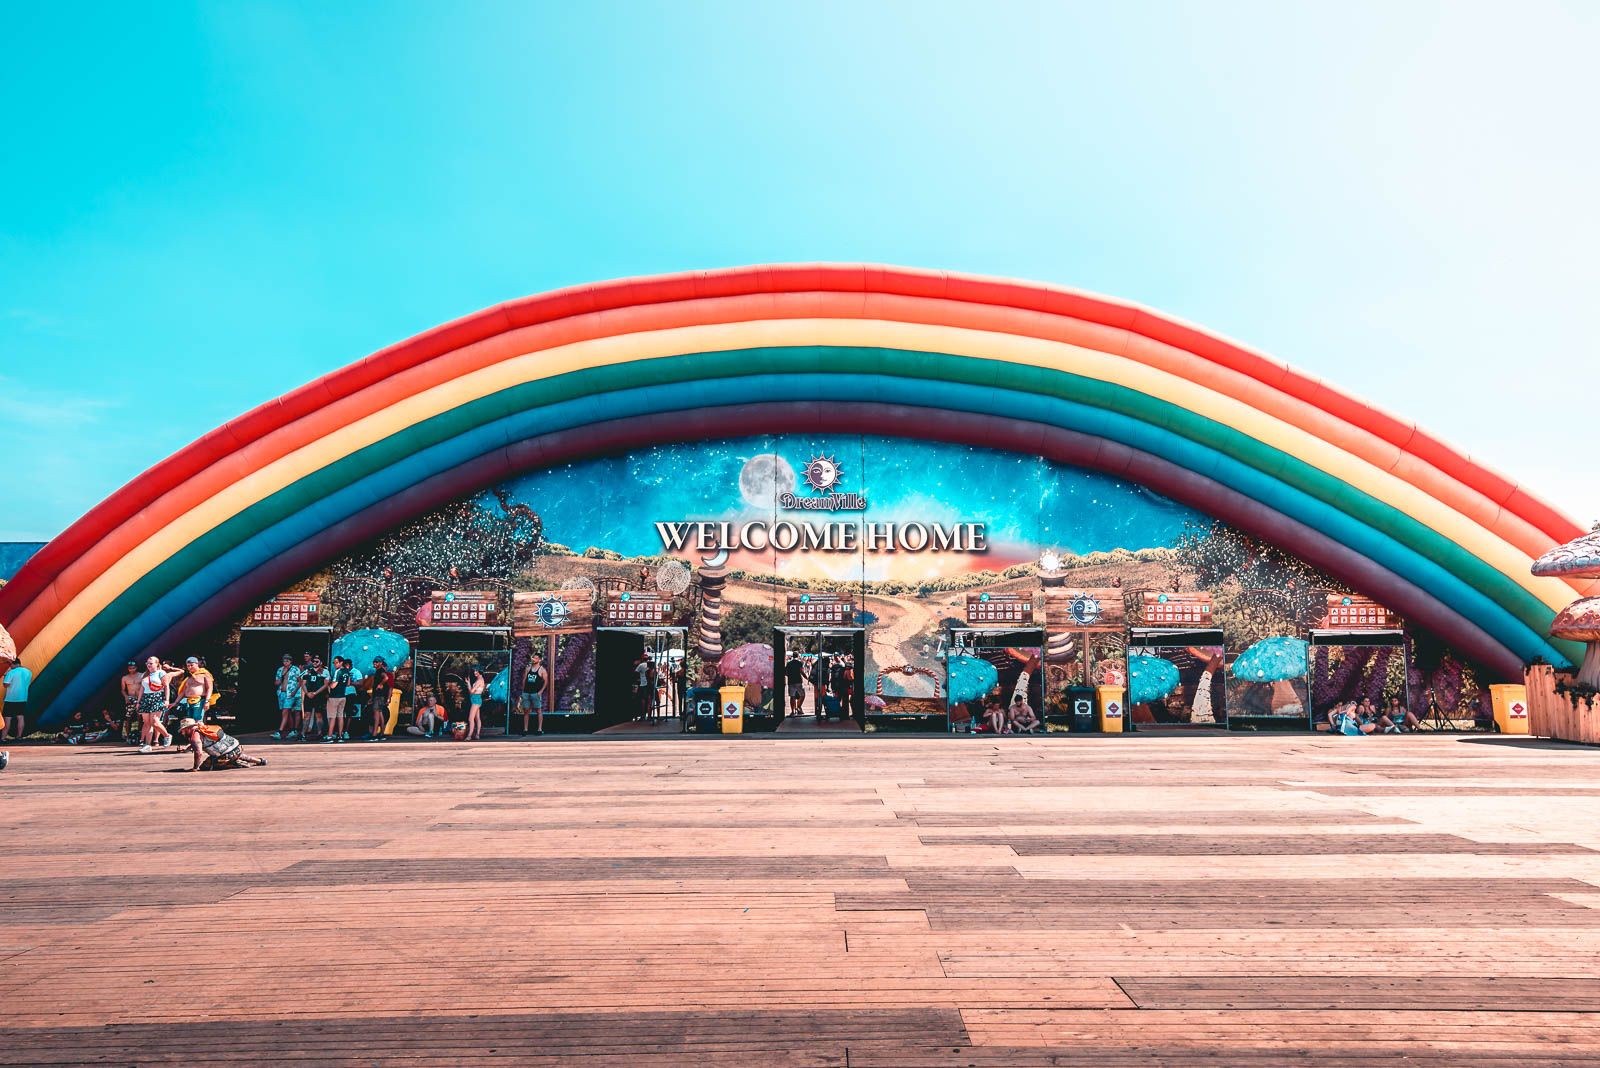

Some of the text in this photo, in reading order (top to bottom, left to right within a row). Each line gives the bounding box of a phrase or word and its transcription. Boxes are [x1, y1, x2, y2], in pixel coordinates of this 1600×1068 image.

[779, 492, 867, 511] DreamVille
[654, 522, 987, 551] WELCOME HOME
